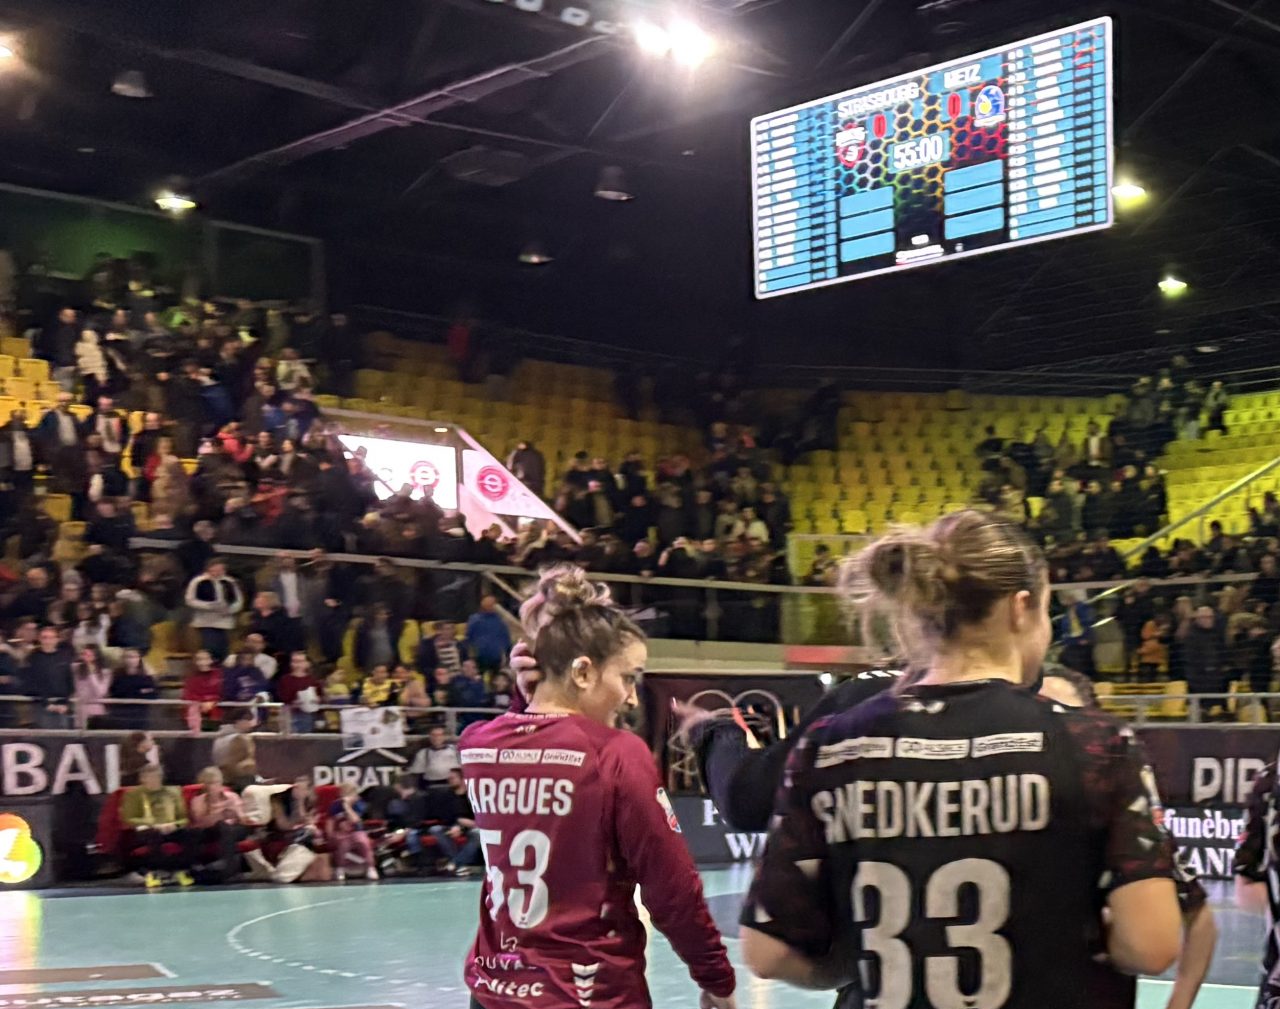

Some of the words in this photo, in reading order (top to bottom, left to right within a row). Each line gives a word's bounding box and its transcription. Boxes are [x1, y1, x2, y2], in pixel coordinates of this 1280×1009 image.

[313, 765, 400, 795] PIRAT
[464, 777, 574, 816] ARGUES
[811, 773, 1050, 844] SNEDKERUD
[1163, 808, 1249, 839] funèbr
[479, 829, 550, 929] 53
